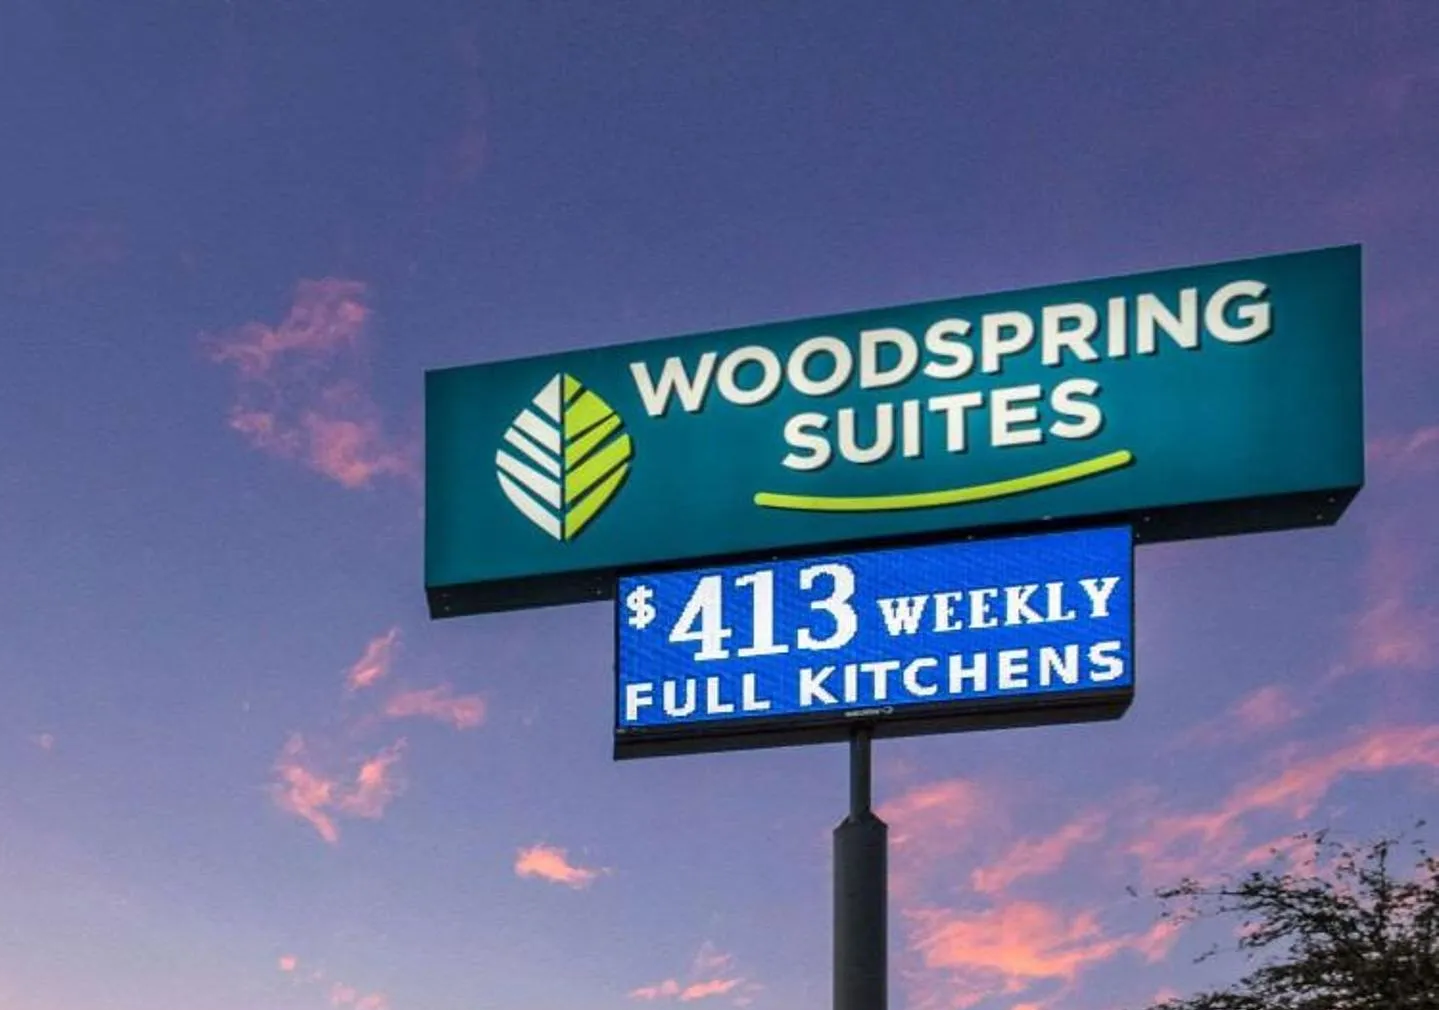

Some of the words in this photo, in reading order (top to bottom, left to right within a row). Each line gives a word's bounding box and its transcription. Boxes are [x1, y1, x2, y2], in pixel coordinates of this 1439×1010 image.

[630, 280, 1270, 417] WOODSPRING
[782, 378, 1102, 471] SUITES
[626, 585, 656, 630] $
[668, 563, 858, 661] 413
[877, 576, 1120, 637] WEEKLY
[625, 673, 771, 721] FULL
[799, 640, 1124, 706] KITCHENS
